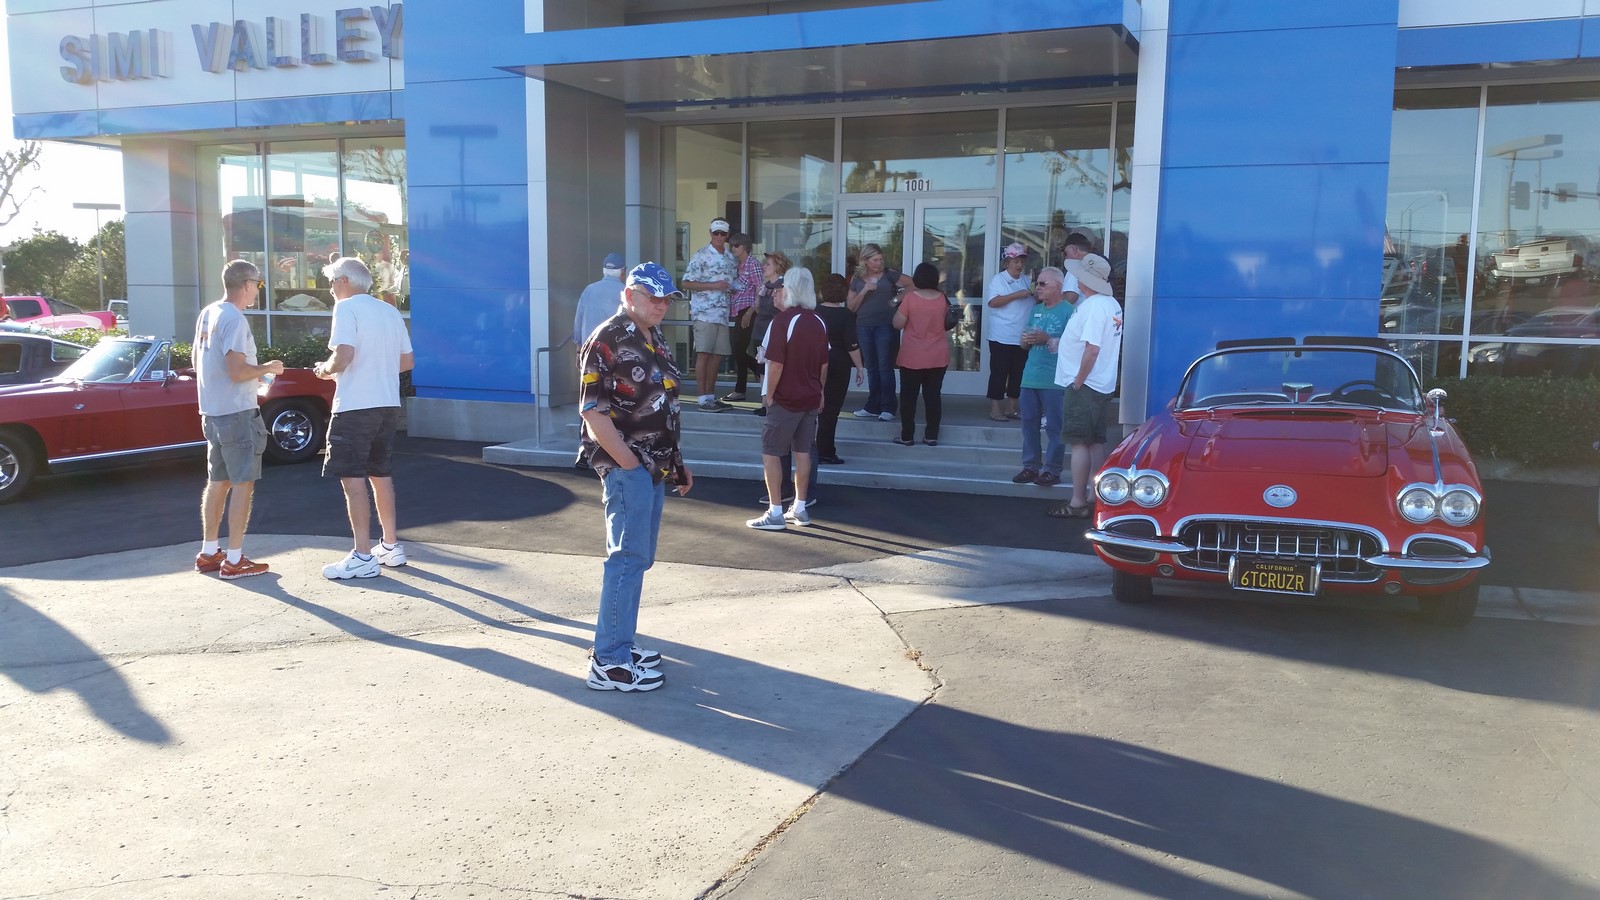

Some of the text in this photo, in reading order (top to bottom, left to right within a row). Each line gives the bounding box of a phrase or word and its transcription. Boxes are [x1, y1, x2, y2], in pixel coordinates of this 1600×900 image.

[59, 4, 403, 84] SIMI VALLEY
[905, 179, 930, 192] 1001
[1241, 571, 1304, 590] 6TCRUZR
